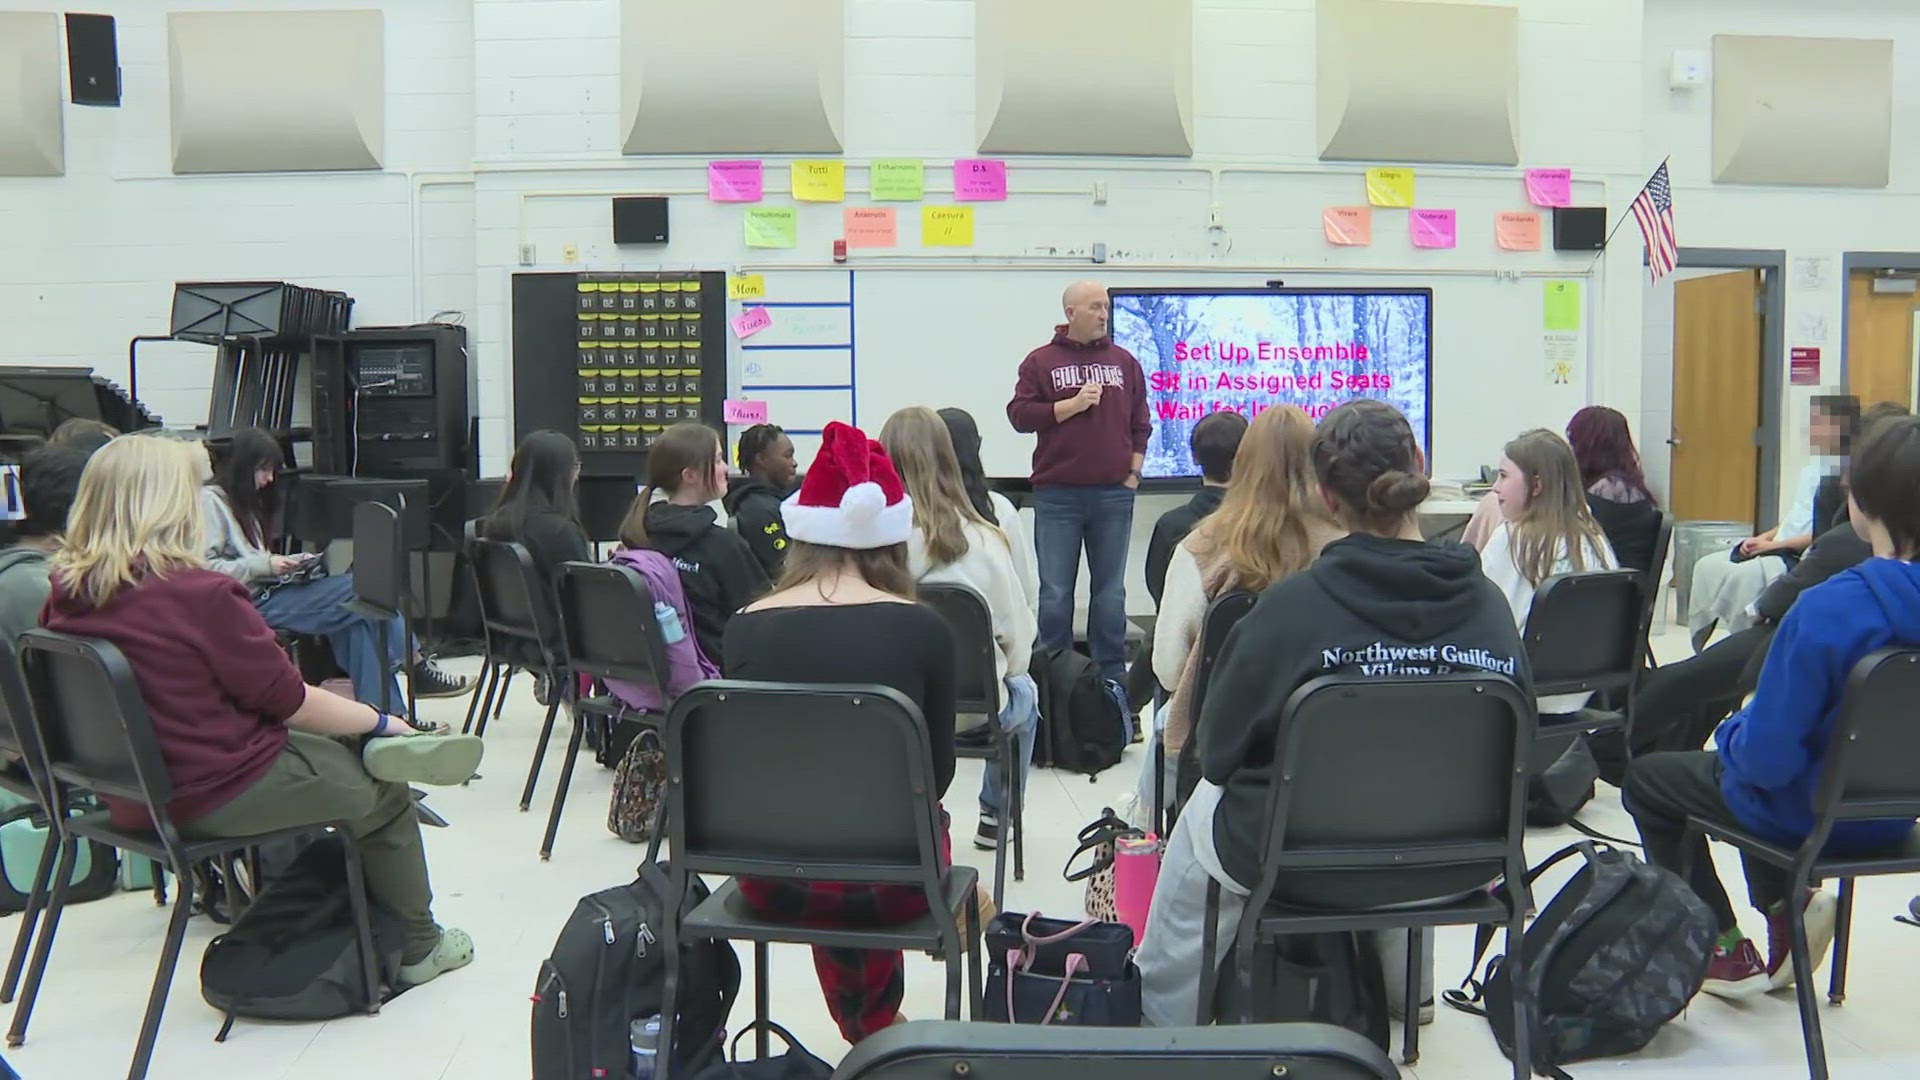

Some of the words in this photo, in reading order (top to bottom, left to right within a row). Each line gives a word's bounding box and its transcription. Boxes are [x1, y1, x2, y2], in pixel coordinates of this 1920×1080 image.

[808, 165, 829, 175] Tutti
[930, 210, 965, 220] Caesura
[733, 283, 761, 295] Mon.
[581, 297, 592, 308] 01
[602, 298, 614, 308] 02
[623, 298, 635, 309] 03
[643, 298, 655, 309] 04
[664, 297, 676, 308] 05
[684, 297, 697, 308] 06
[581, 326, 593, 336] 07
[604, 326, 616, 336] 08
[624, 326, 636, 336] 09
[644, 326, 656, 336] 10
[665, 326, 675, 336] 11
[685, 325, 697, 336] 12
[740, 318, 768, 332] Tues.
[582, 354, 593, 364] 13
[604, 354, 615, 364] 14
[624, 354, 635, 364] 15
[645, 354, 656, 364] 16
[665, 354, 676, 364] 17
[685, 354, 696, 364] 18
[1174, 341, 1211, 362] Set
[1219, 342, 1250, 366] Up
[1257, 341, 1369, 361] Ensemble
[584, 383, 595, 392] 19
[604, 383, 616, 392] 20
[624, 383, 634, 392] 21
[644, 383, 656, 392] 22
[665, 382, 677, 392] 23
[685, 382, 697, 392] 24
[1150, 371, 1181, 392] Sit
[1188, 371, 1209, 391] in
[1216, 371, 1323, 396] Assigned
[1330, 370, 1393, 392] Seats
[583, 409, 595, 419] 25
[604, 409, 616, 419] 26
[625, 409, 637, 419] 27
[644, 408, 657, 419] 28
[665, 408, 677, 419] 29
[686, 408, 698, 419] 30
[728, 407, 764, 420] Thurs.
[1155, 400, 1205, 421] Wait
[585, 437, 596, 446] 31
[604, 437, 616, 446] 32
[625, 437, 638, 446] 33
[1320, 641, 1437, 669] Northwest
[1441, 644, 1516, 676] Guilford
